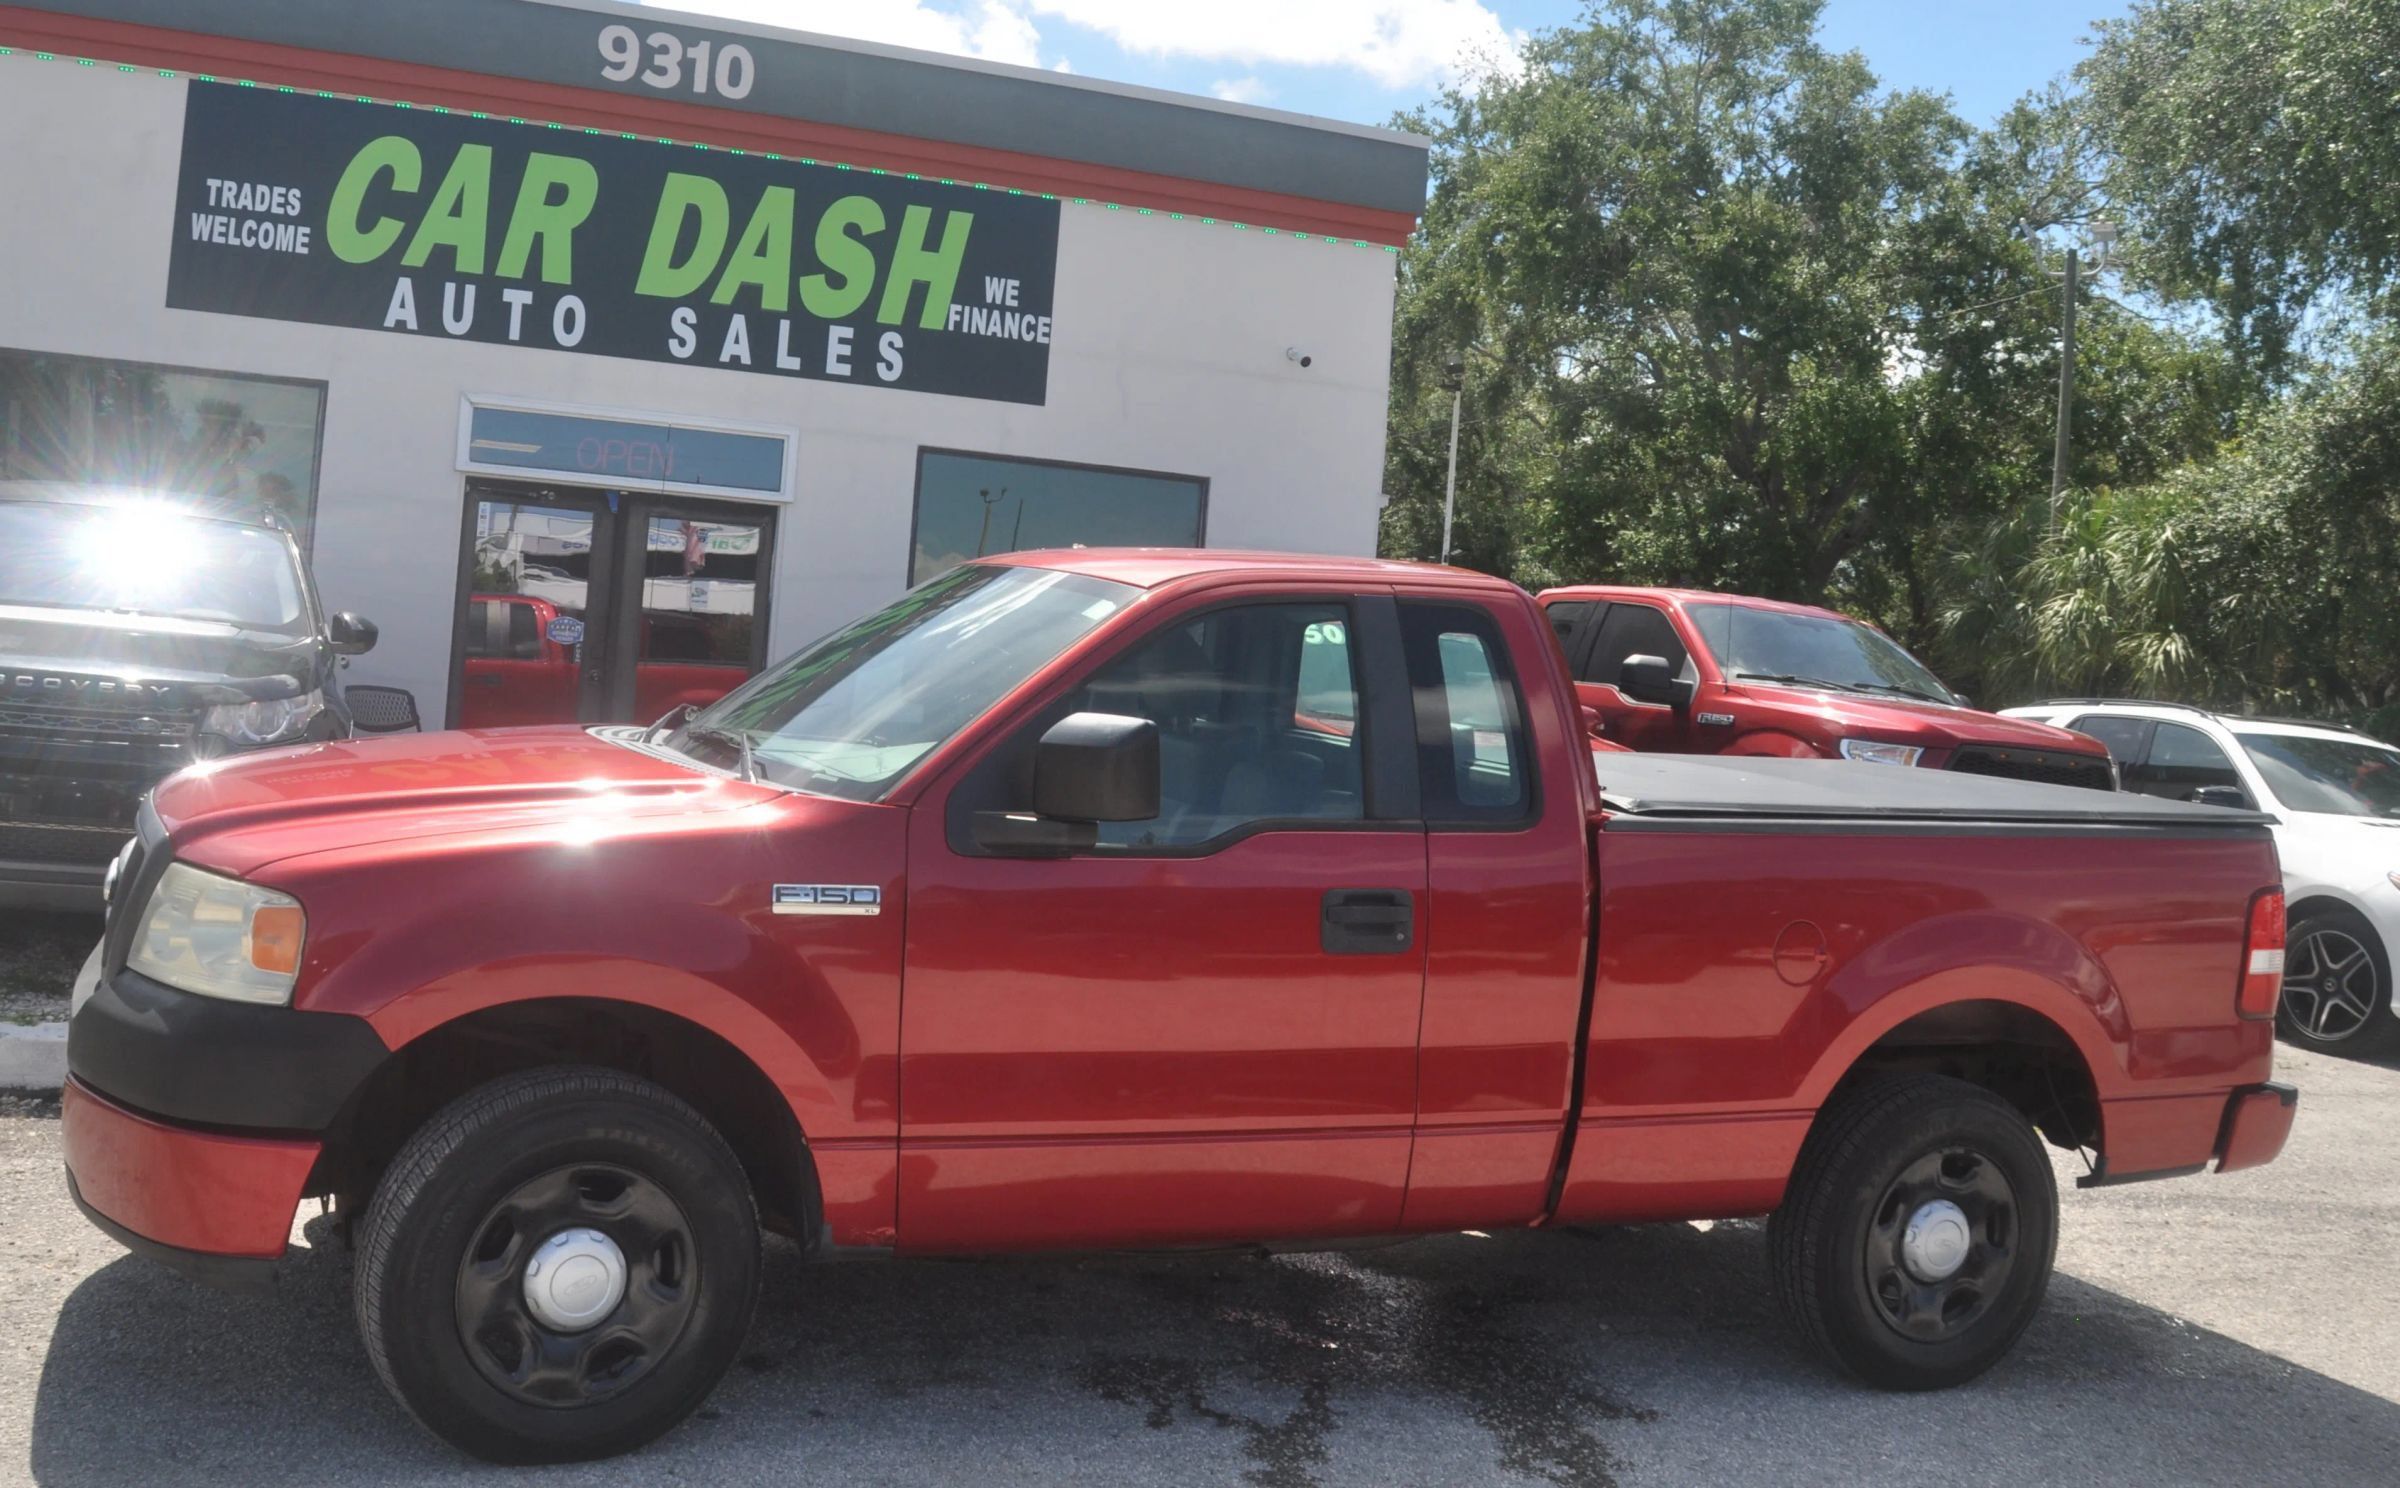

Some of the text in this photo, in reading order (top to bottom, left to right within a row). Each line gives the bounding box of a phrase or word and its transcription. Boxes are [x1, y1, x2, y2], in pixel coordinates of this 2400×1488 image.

[598, 24, 756, 100] 9310
[206, 178, 302, 216] TRADES
[191, 212, 312, 254] WELCOME
[326, 135, 975, 331] CAR DASH
[984, 276, 1020, 307] WE
[383, 276, 904, 382] AUTO SALES
[947, 304, 1052, 344] FINANCE
[576, 437, 674, 477] OPEN
[774, 886, 878, 905] F-150
